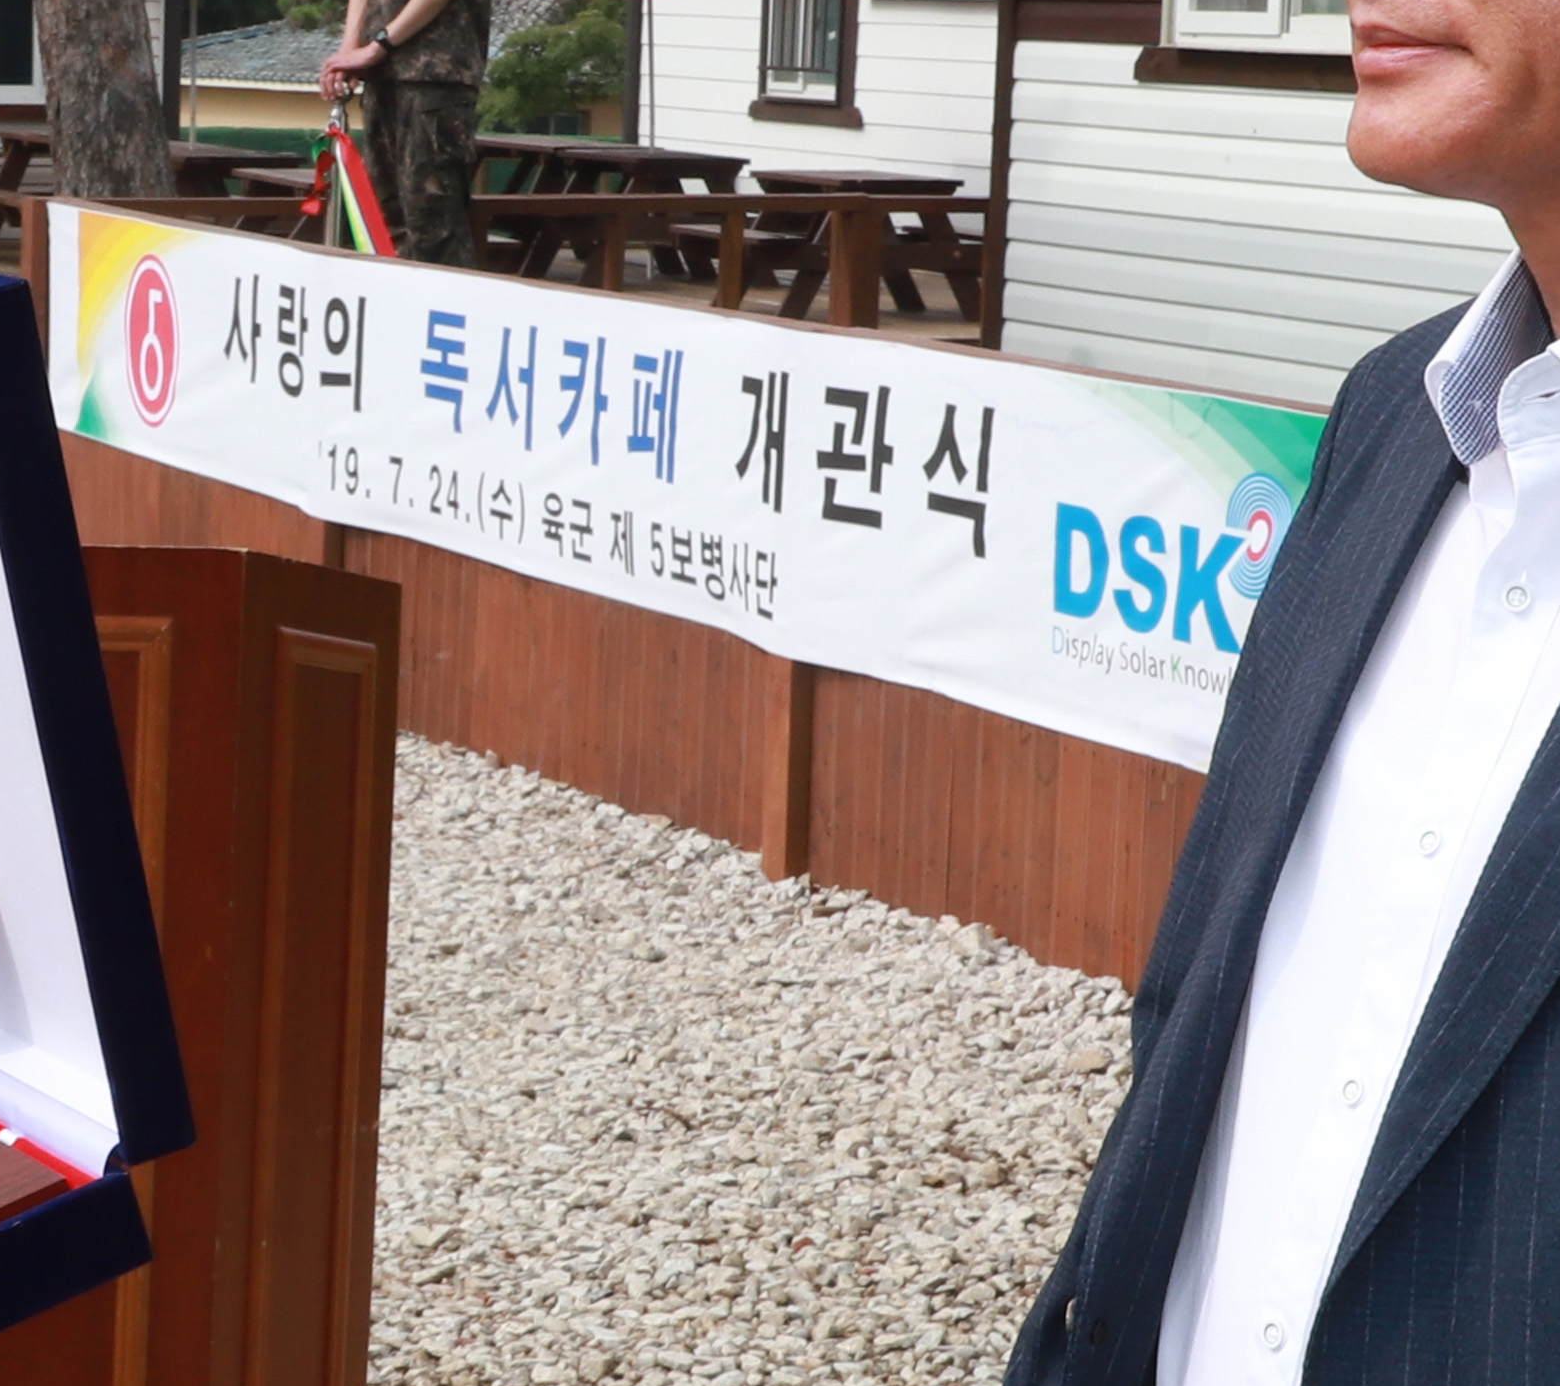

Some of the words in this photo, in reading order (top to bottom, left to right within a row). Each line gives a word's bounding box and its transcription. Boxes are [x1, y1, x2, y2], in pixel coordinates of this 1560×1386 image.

[224, 274, 366, 412] 사랑의
[421, 309, 684, 484] 독서카페
[735, 371, 995, 558] 개관식
[541, 493, 594, 563] 육군
[650, 522, 778, 620] 5보병사단
[1053, 501, 1246, 654] DSK
[1052, 625, 1116, 674] Display
[1119, 642, 1166, 680] Solar
[1171, 654, 1235, 695] Knowl
